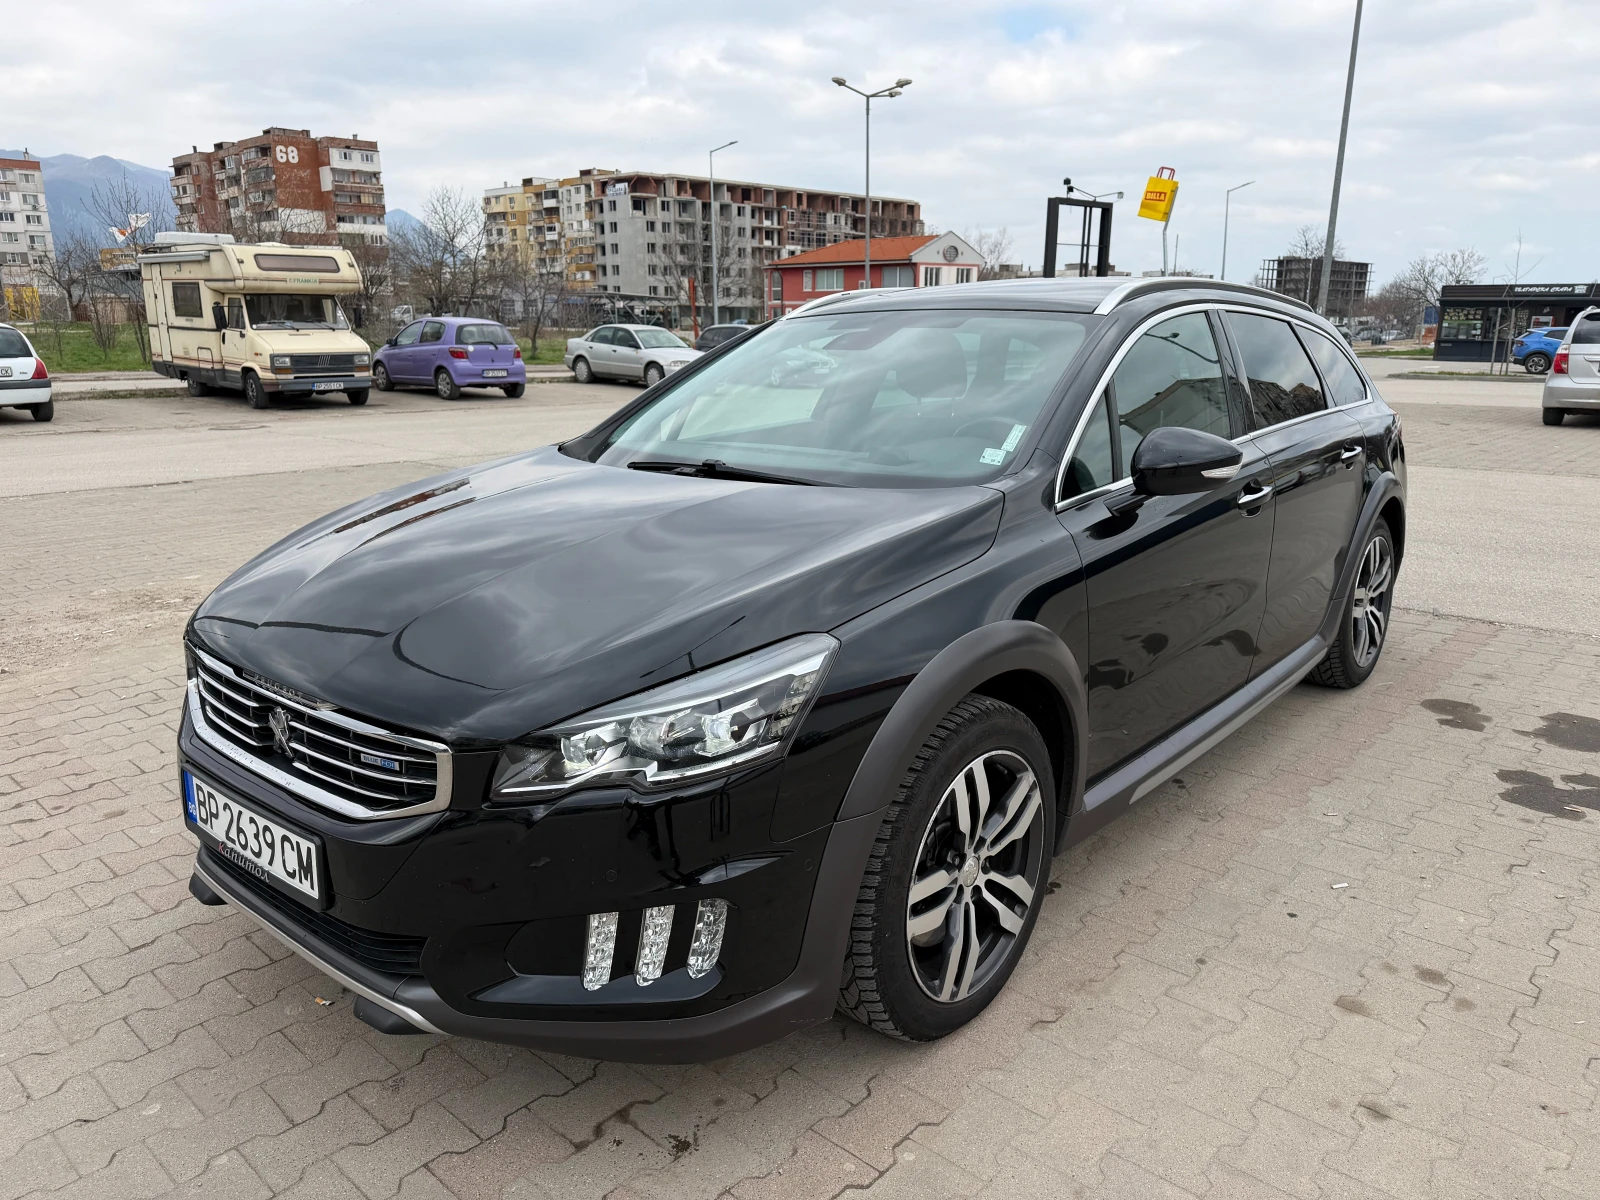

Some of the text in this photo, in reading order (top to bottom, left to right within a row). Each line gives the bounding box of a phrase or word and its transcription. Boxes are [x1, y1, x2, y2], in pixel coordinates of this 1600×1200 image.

[275, 145, 299, 164] 68
[1146, 192, 1165, 201] BILLA
[0, 368, 10, 376] CK
[363, 755, 379, 764] BLUE
[189, 802, 197, 816] BG
[195, 783, 315, 891] BP 2639 CM
